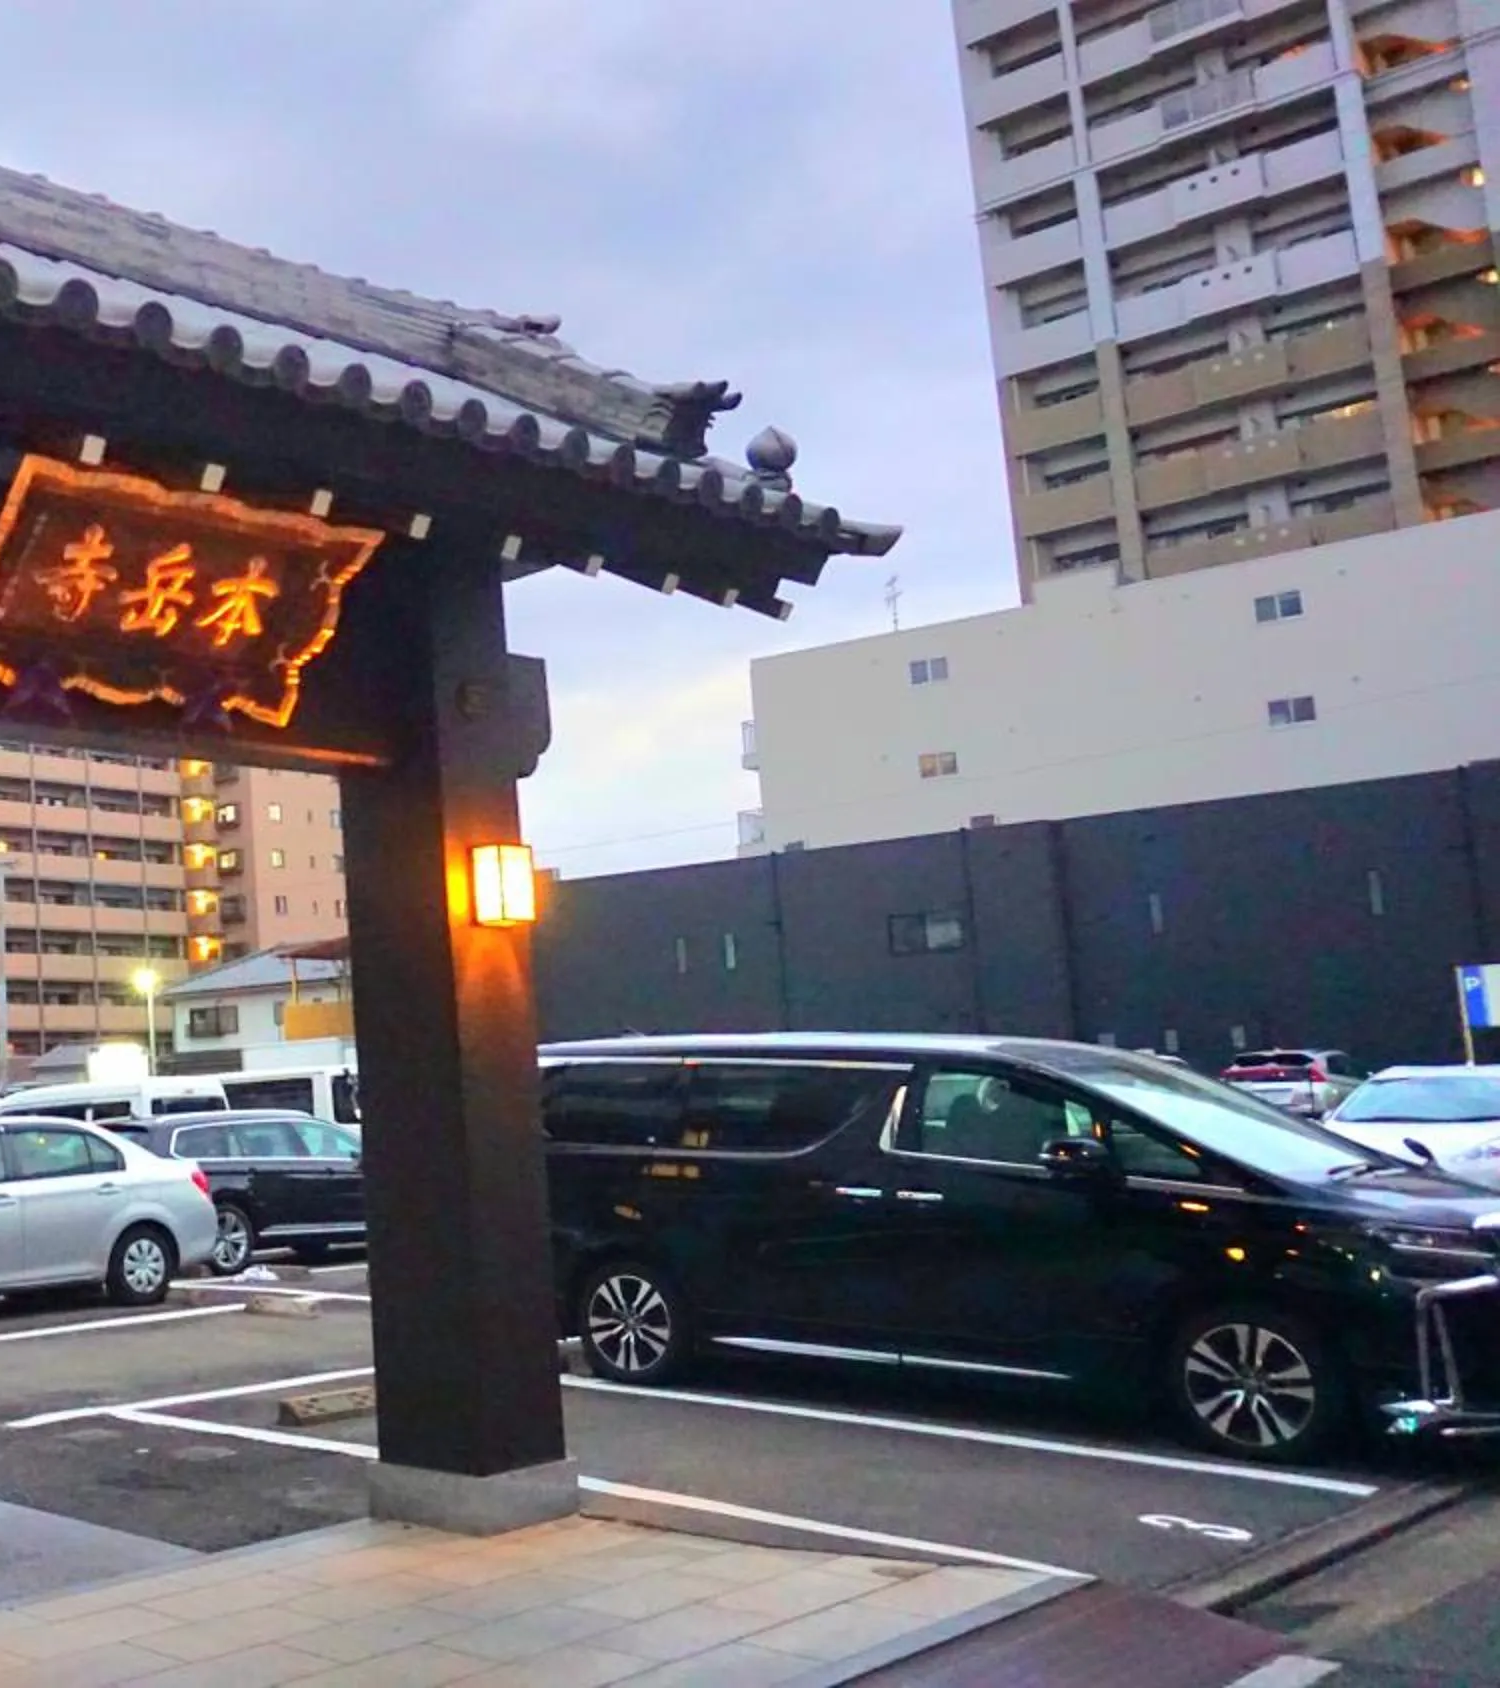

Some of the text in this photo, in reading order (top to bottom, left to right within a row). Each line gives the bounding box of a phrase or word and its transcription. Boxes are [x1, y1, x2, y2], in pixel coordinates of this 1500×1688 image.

[33, 523, 280, 647] 本岳寺
[1463, 976, 1480, 993] P
